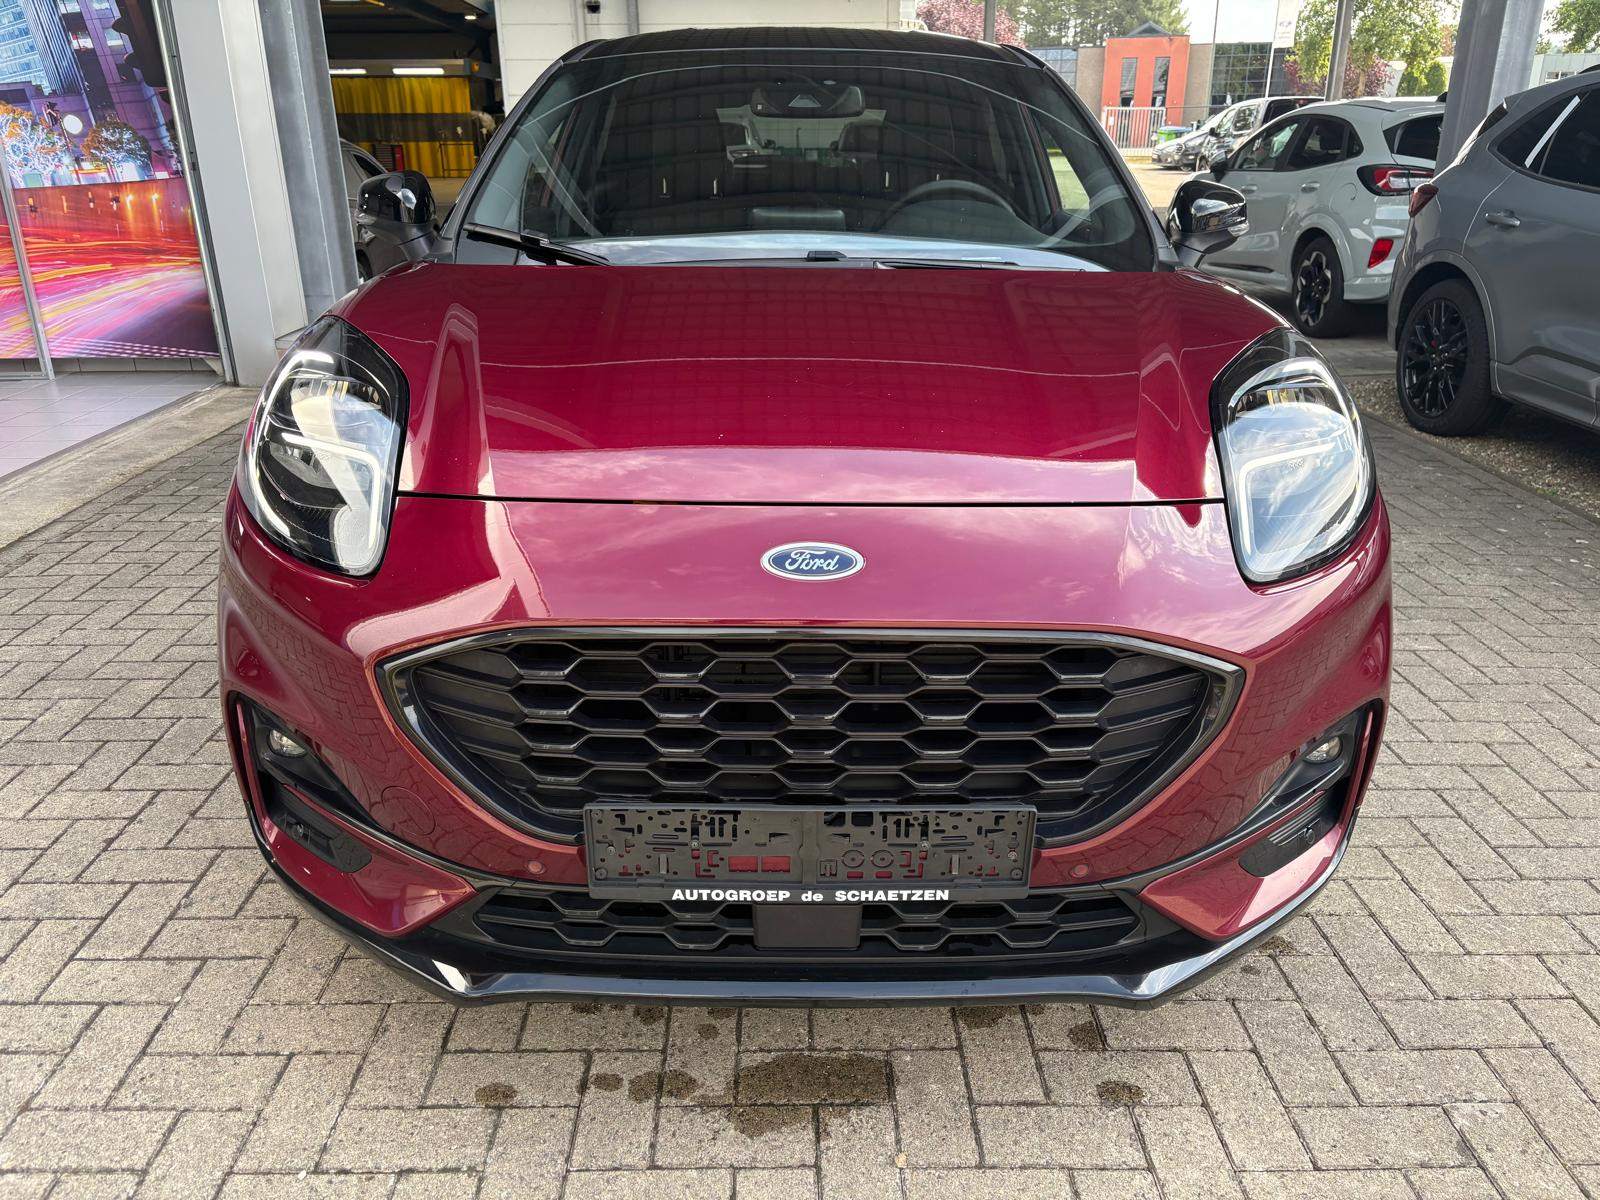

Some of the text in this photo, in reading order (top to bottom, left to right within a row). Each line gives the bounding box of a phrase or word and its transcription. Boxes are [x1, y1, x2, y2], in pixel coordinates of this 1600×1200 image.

[784, 549, 840, 571] Ford
[671, 889, 950, 902] AUTOGROEP de SCHAETZEN
